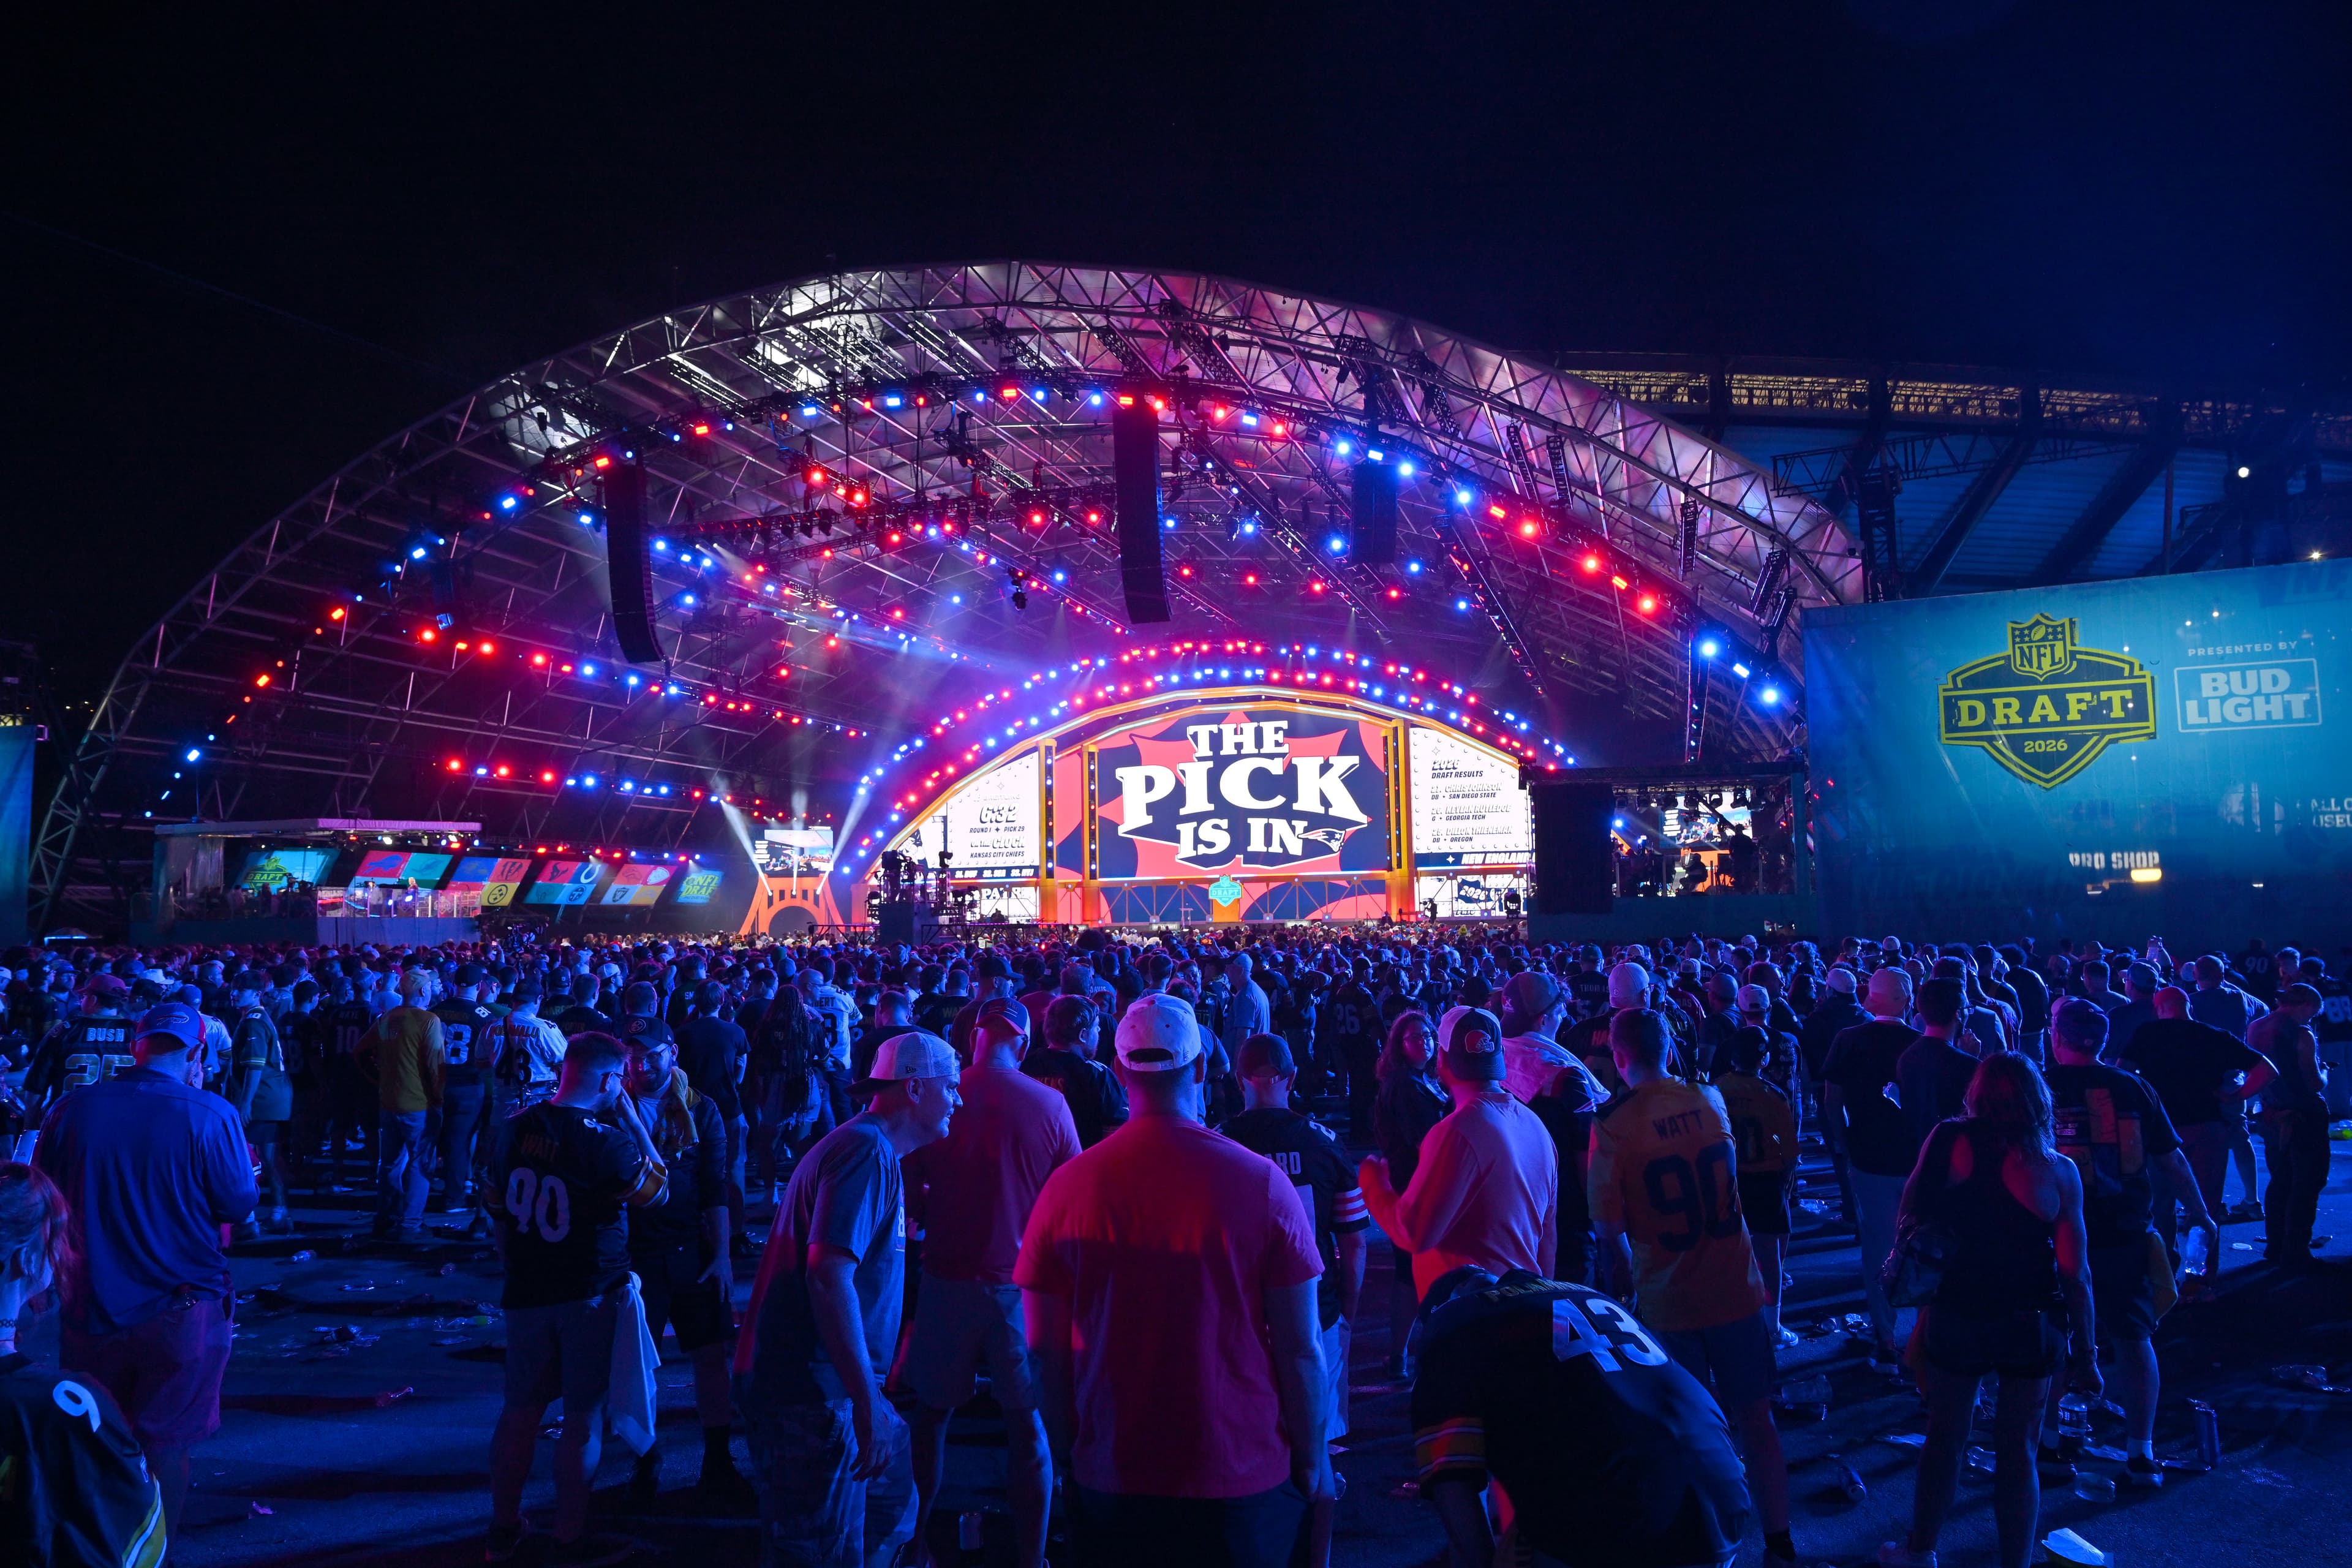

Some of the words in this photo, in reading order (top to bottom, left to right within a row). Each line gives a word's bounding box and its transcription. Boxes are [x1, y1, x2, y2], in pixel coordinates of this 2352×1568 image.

[2018, 643, 2062, 671] NFL
[2188, 644, 2272, 657] PRESENTED
[2278, 641, 2297, 650] BY
[2200, 668, 2291, 698] BUD
[1957, 689, 2133, 727] DRAFT
[2185, 693, 2310, 725] LIGHT
[1187, 720, 1289, 758] THE
[2024, 739, 2068, 753] 2026
[1432, 759, 1460, 771] 2026
[1115, 755, 1368, 834] PICK
[980, 802, 1019, 824] 6:32
[992, 835, 1025, 848] CLOCK
[1176, 818, 1231, 859] IS
[1247, 818, 1308, 856] IN
[1461, 853, 1485, 864] NEW
[2069, 853, 2105, 869] PRO
[2111, 851, 2160, 869] SHOP
[1460, 886, 1488, 900] 2026
[2245, 956, 2268, 974] 90
[86, 1028, 124, 1042] BUSH
[1654, 1109, 1703, 1140] WATT
[505, 1167, 571, 1243] 90
[1642, 1139, 1743, 1251] 90
[1553, 1298, 1668, 1373] 43
[53, 1381, 101, 1433] 9
